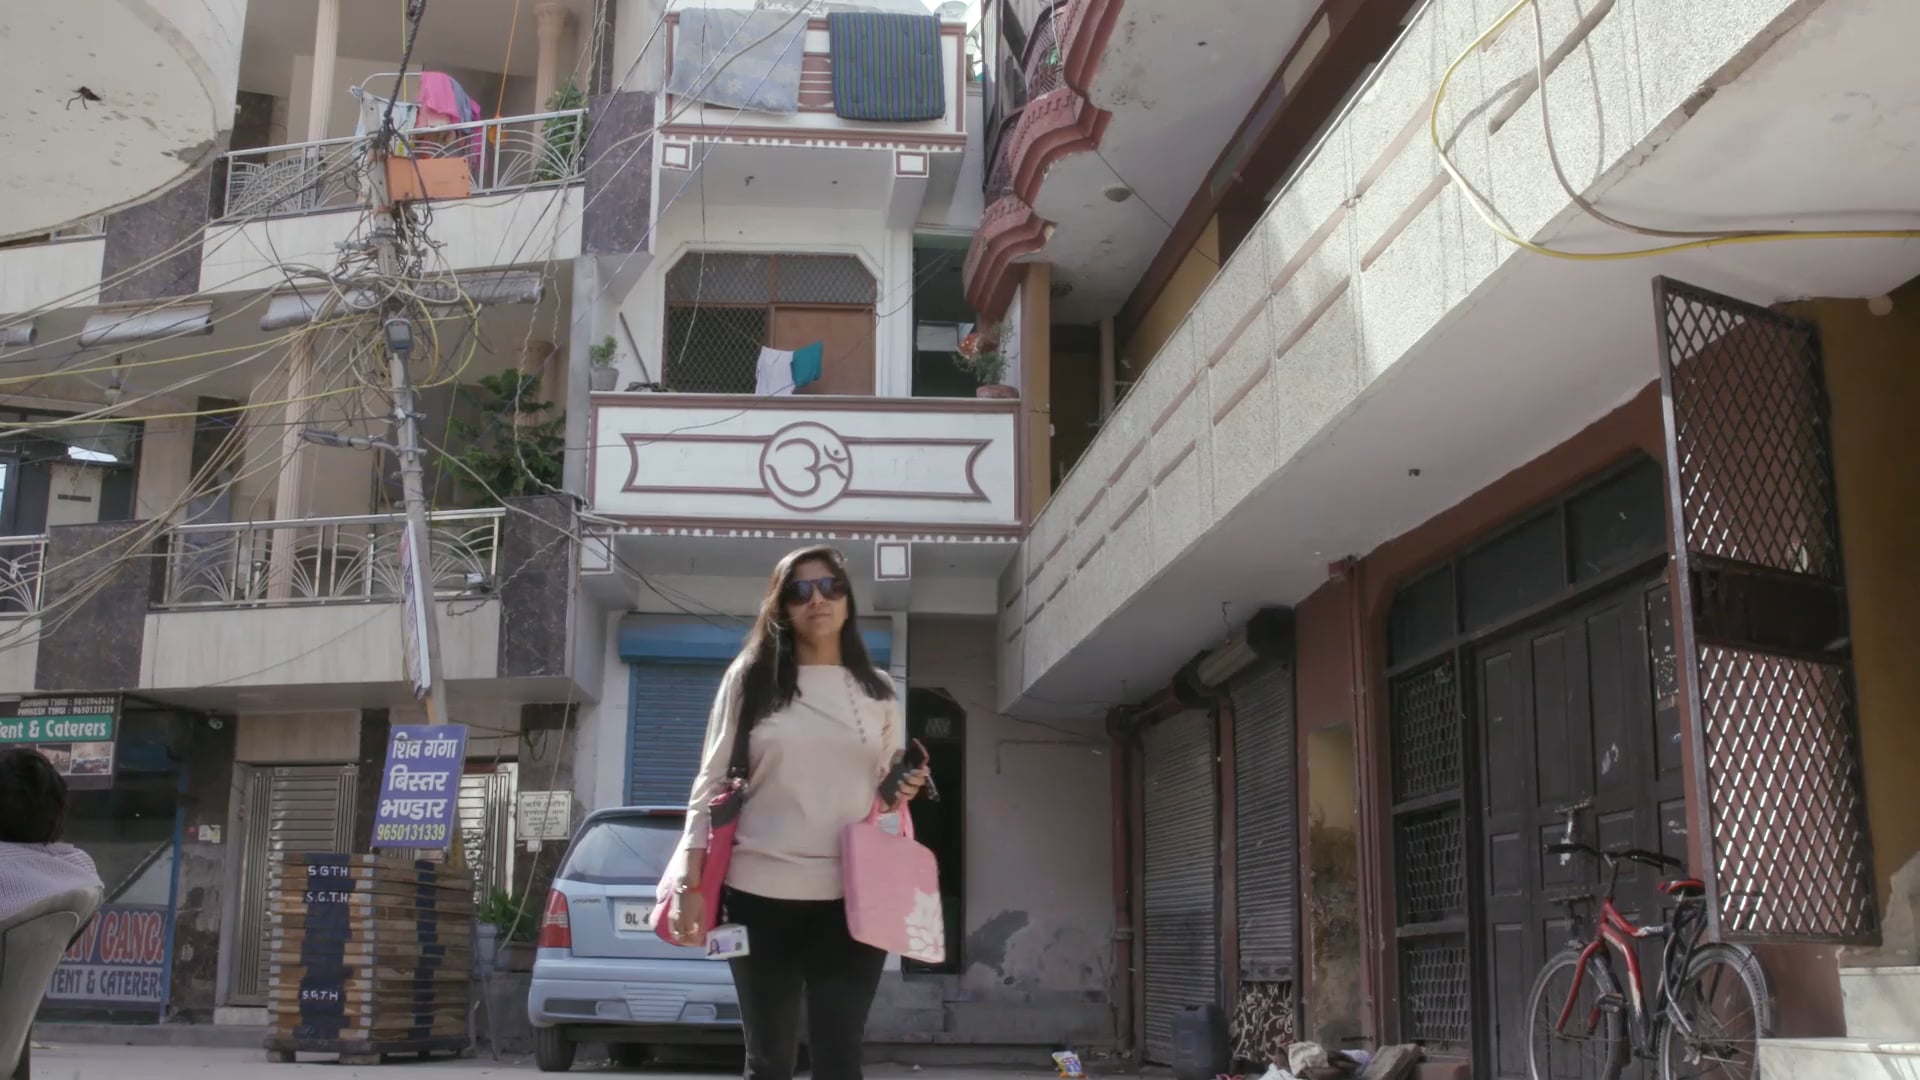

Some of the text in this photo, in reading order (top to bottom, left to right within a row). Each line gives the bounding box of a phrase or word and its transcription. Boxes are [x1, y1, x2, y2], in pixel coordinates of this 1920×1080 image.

[0, 720, 106, 738] ent & Caterers
[392, 731, 459, 759] शिव गंगा
[388, 764, 450, 791] बिस्तर
[380, 798, 448, 820] भण्डार
[376, 823, 446, 841] 9650131339
[625, 912, 639, 925] DL
[87, 969, 95, 994] &
[100, 970, 161, 998] CATERER
